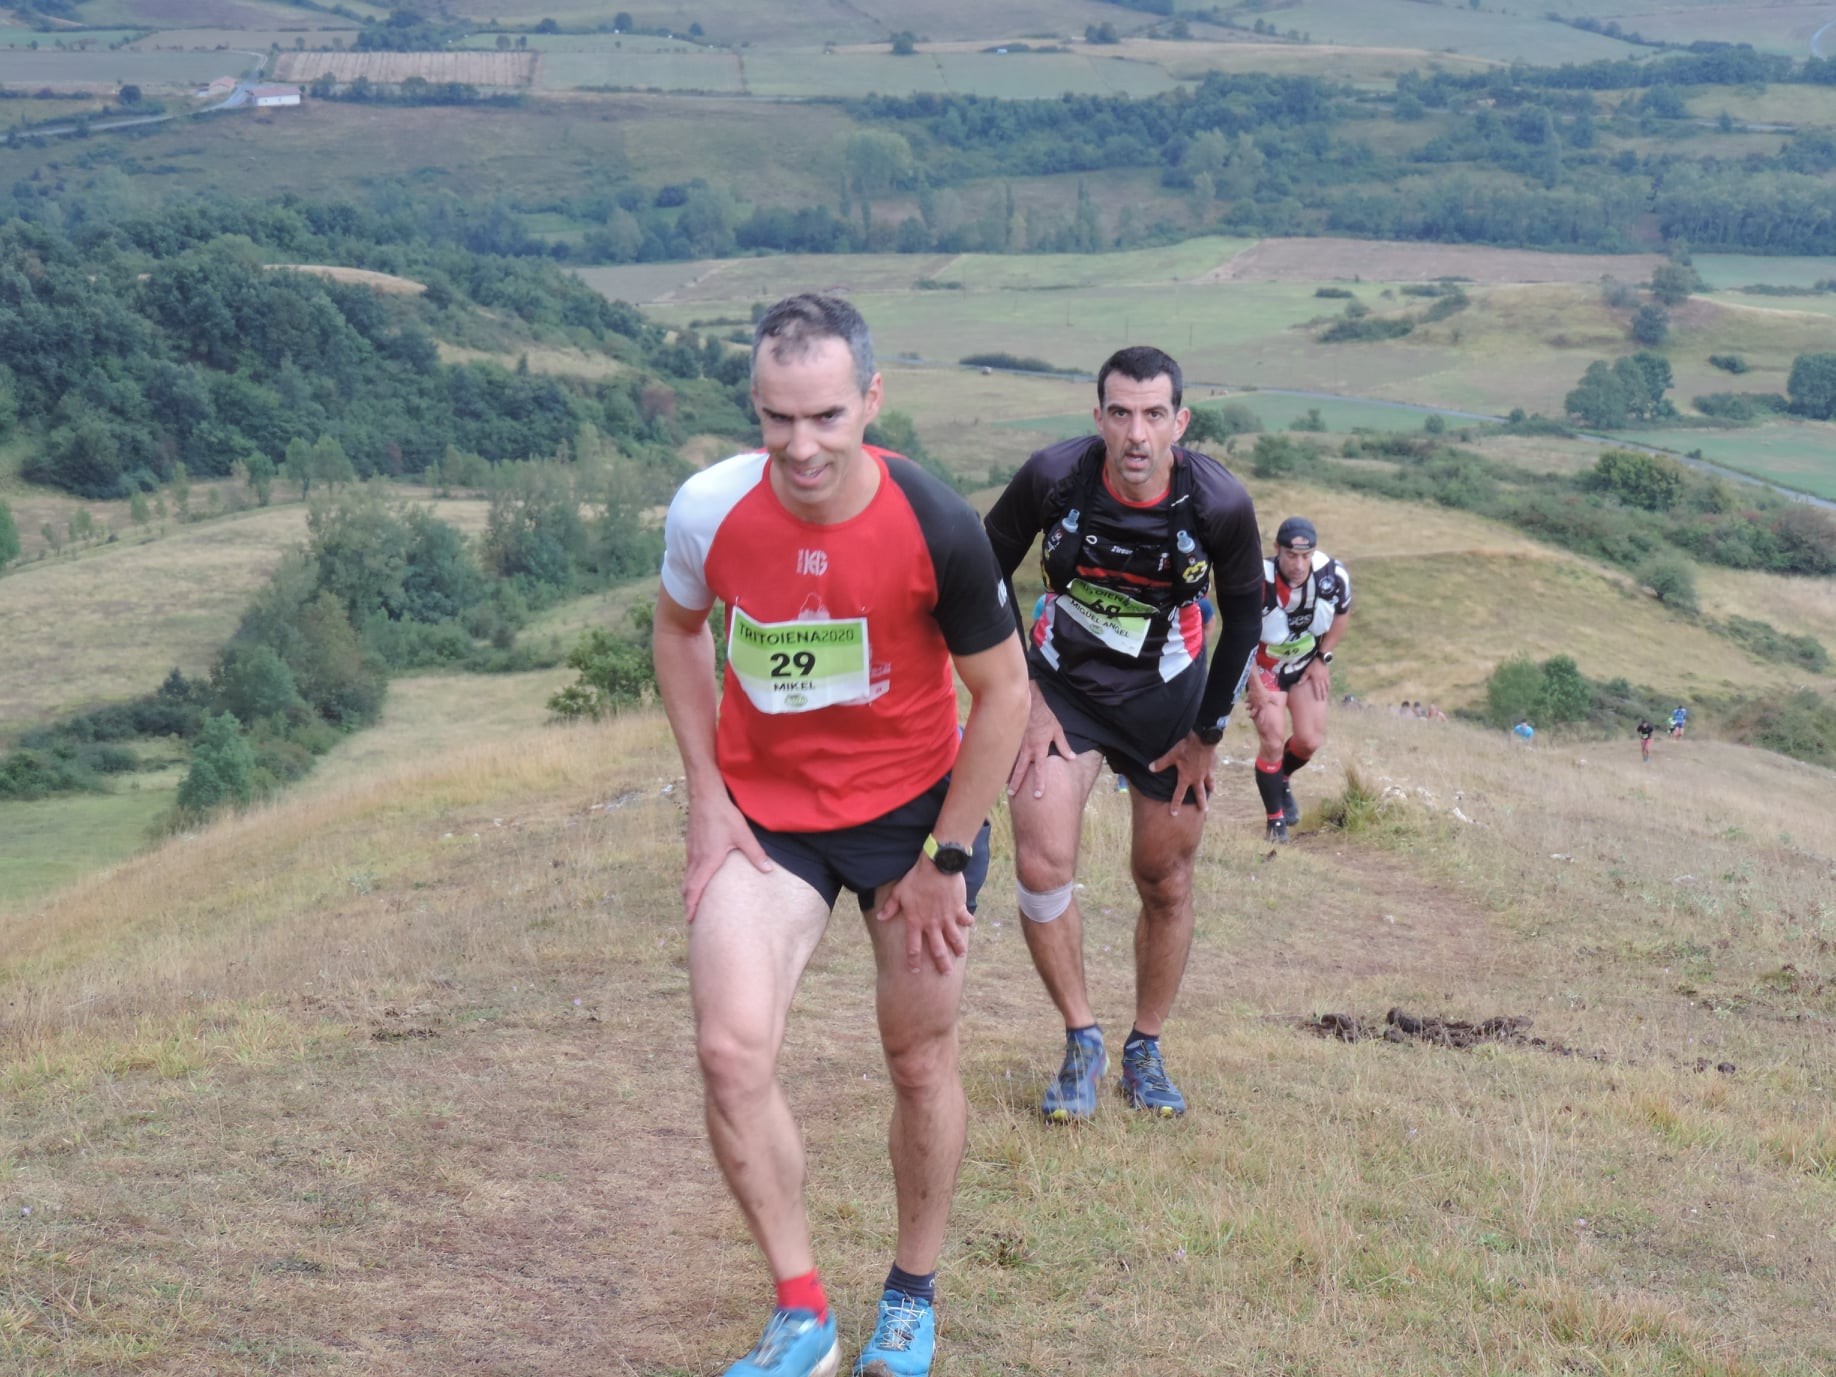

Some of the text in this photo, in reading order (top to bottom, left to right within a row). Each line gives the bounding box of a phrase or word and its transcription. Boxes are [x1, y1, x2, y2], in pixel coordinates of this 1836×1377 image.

[1070, 599, 1101, 624] MIGUEL
[1102, 621, 1130, 638] ANGEL
[769, 651, 816, 678] 29
[773, 681, 815, 692] MIKEL
